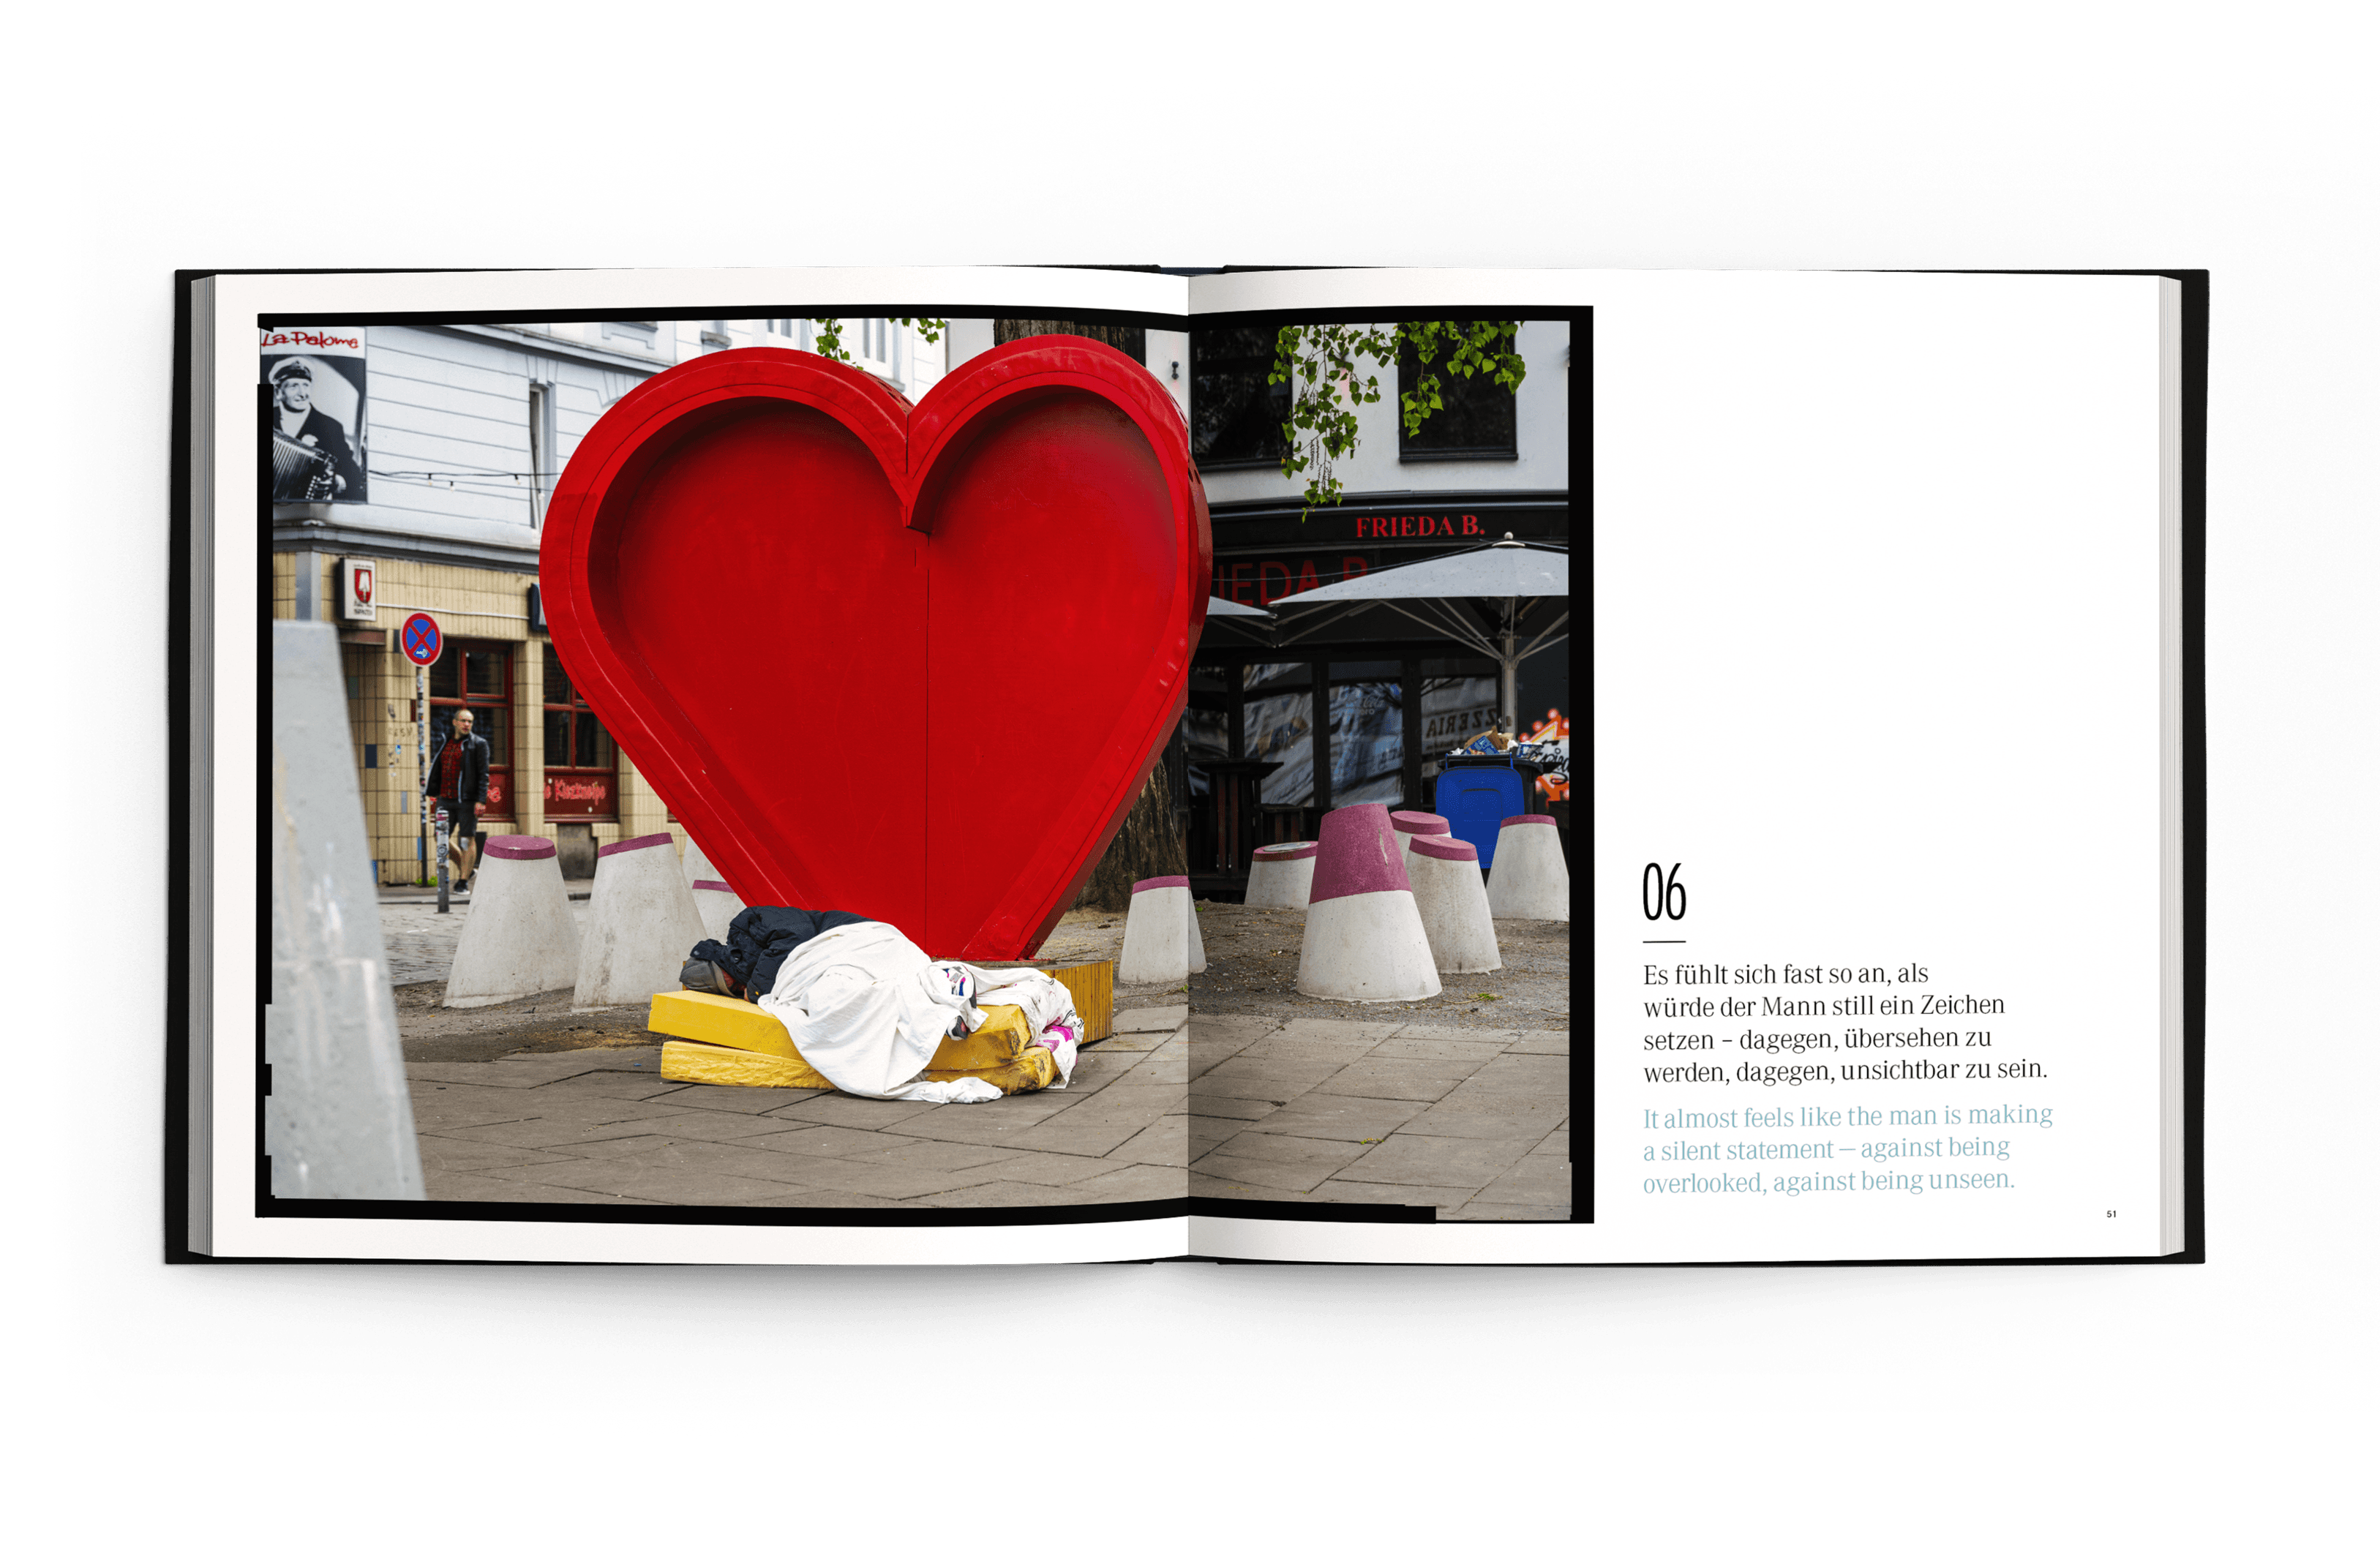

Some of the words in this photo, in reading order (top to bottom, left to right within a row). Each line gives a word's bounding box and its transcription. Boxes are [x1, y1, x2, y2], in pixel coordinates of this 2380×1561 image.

[261, 334, 290, 347] La
[290, 331, 358, 349] Paloma
[1356, 516, 1455, 538] FRIEDA
[1462, 514, 1486, 535] B.
[1643, 862, 1687, 922] 06
[1643, 965, 1669, 985] Es
[1675, 964, 1729, 985] fühlt
[1735, 963, 1778, 985] sich
[1783, 963, 1824, 985] fast
[1829, 967, 1852, 985] so
[1858, 967, 1892, 988] an,
[1898, 962, 1929, 984] als
[1643, 996, 1715, 1018] würde
[1720, 996, 1757, 1018] der
[1761, 996, 1827, 1017] Mann
[1833, 994, 1875, 1016] still
[1880, 995, 1915, 1016] ein
[1921, 993, 2006, 1015] Zeichen
[1643, 1031, 1715, 1051] setzen
[1739, 1028, 1839, 1055] dagegen,
[1844, 1026, 1960, 1049] übersehen
[1965, 1031, 1992, 1047] zu
[1643, 1061, 1730, 1086] werden,
[1736, 1061, 1836, 1087] dagegen,
[1840, 1058, 1961, 1081] unsichtbar
[1965, 1063, 1992, 1079] zu
[1997, 1058, 2048, 1079] sein.
[1644, 1109, 1659, 1129] It
[1664, 1108, 1738, 1129] almost
[1743, 1107, 1794, 1128] feels
[1801, 1106, 1842, 1127] like
[1847, 1105, 1882, 1126] the
[1890, 1109, 1937, 1126] man
[1945, 1105, 1962, 1125] is
[1968, 1104, 2054, 1129] making
[1643, 1146, 1656, 1162] a
[1662, 1140, 1721, 1161] silent
[1727, 1140, 1834, 1160] statement
[1861, 1138, 1943, 1163] against
[1948, 1136, 2011, 1161] being
[1643, 1172, 1767, 1196] overlooked,
[1773, 1171, 1856, 1197] against
[1861, 1170, 1924, 1195] being
[1929, 1173, 2015, 1189] unseen.
[2106, 1209, 2117, 1219] 51
